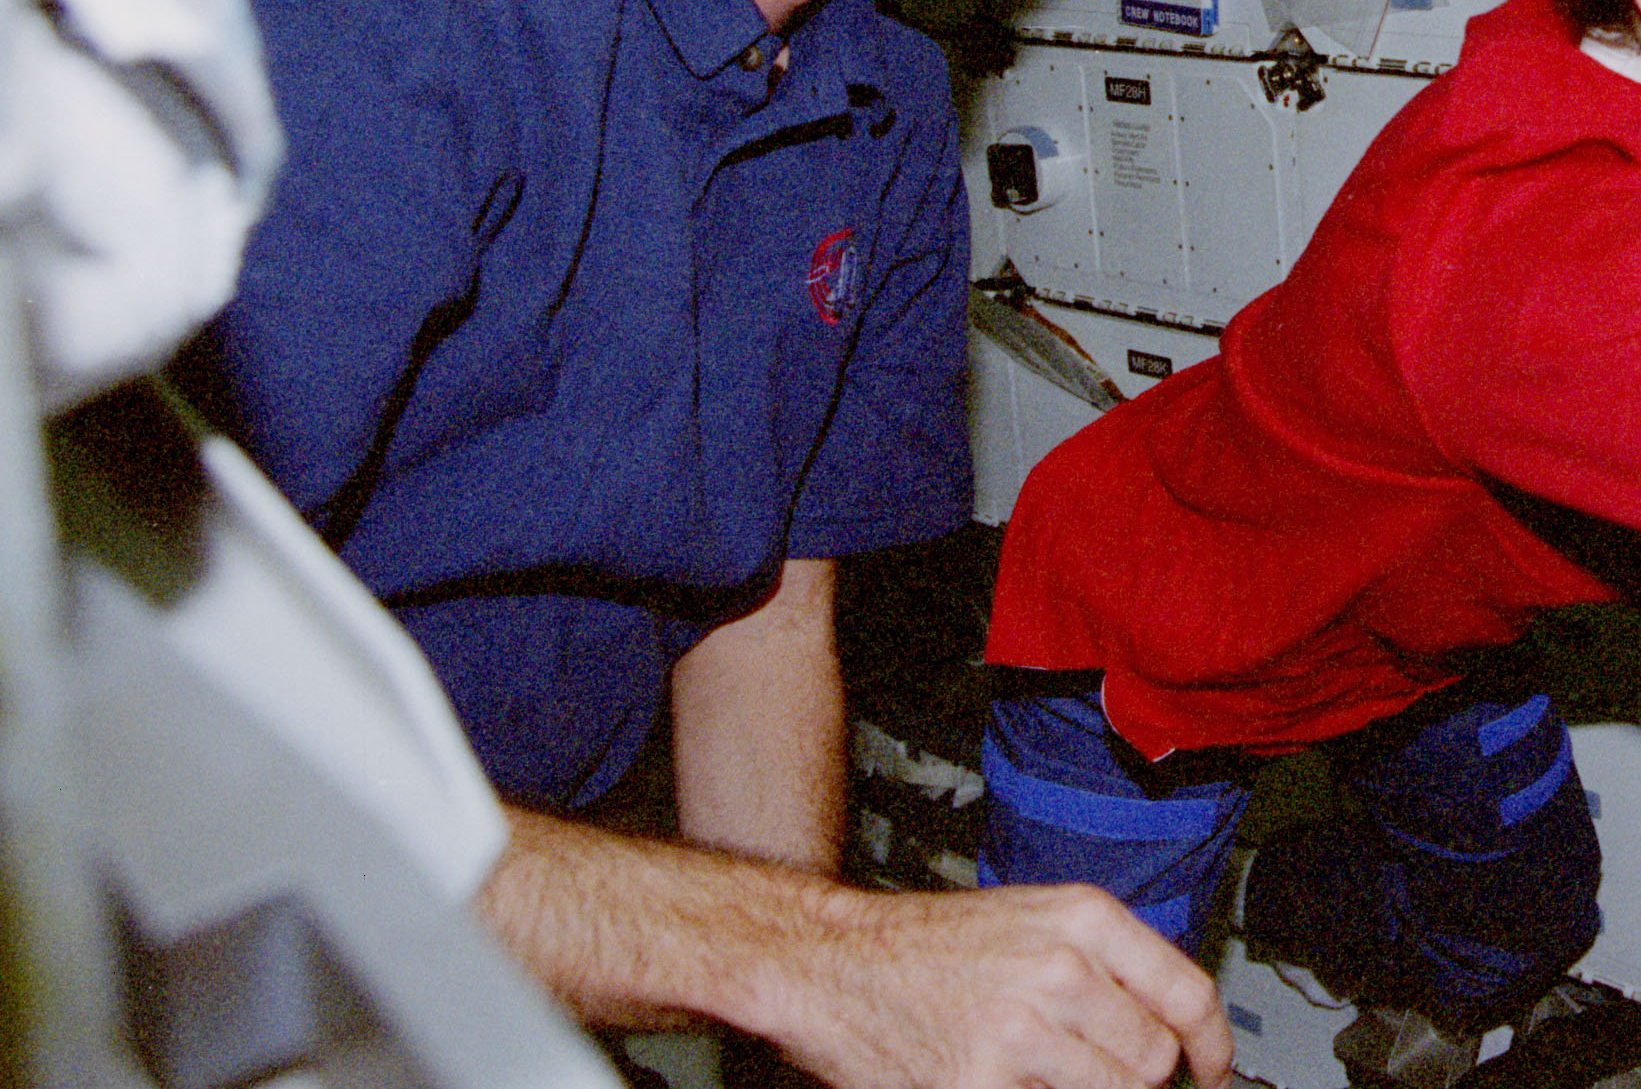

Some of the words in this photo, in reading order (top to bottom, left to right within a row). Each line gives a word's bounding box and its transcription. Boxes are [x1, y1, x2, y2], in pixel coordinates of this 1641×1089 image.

[1125, 5, 1149, 20] CREW
[1153, 10, 1199, 28] NOTEBOOK
[1110, 83, 1146, 101] MF28H
